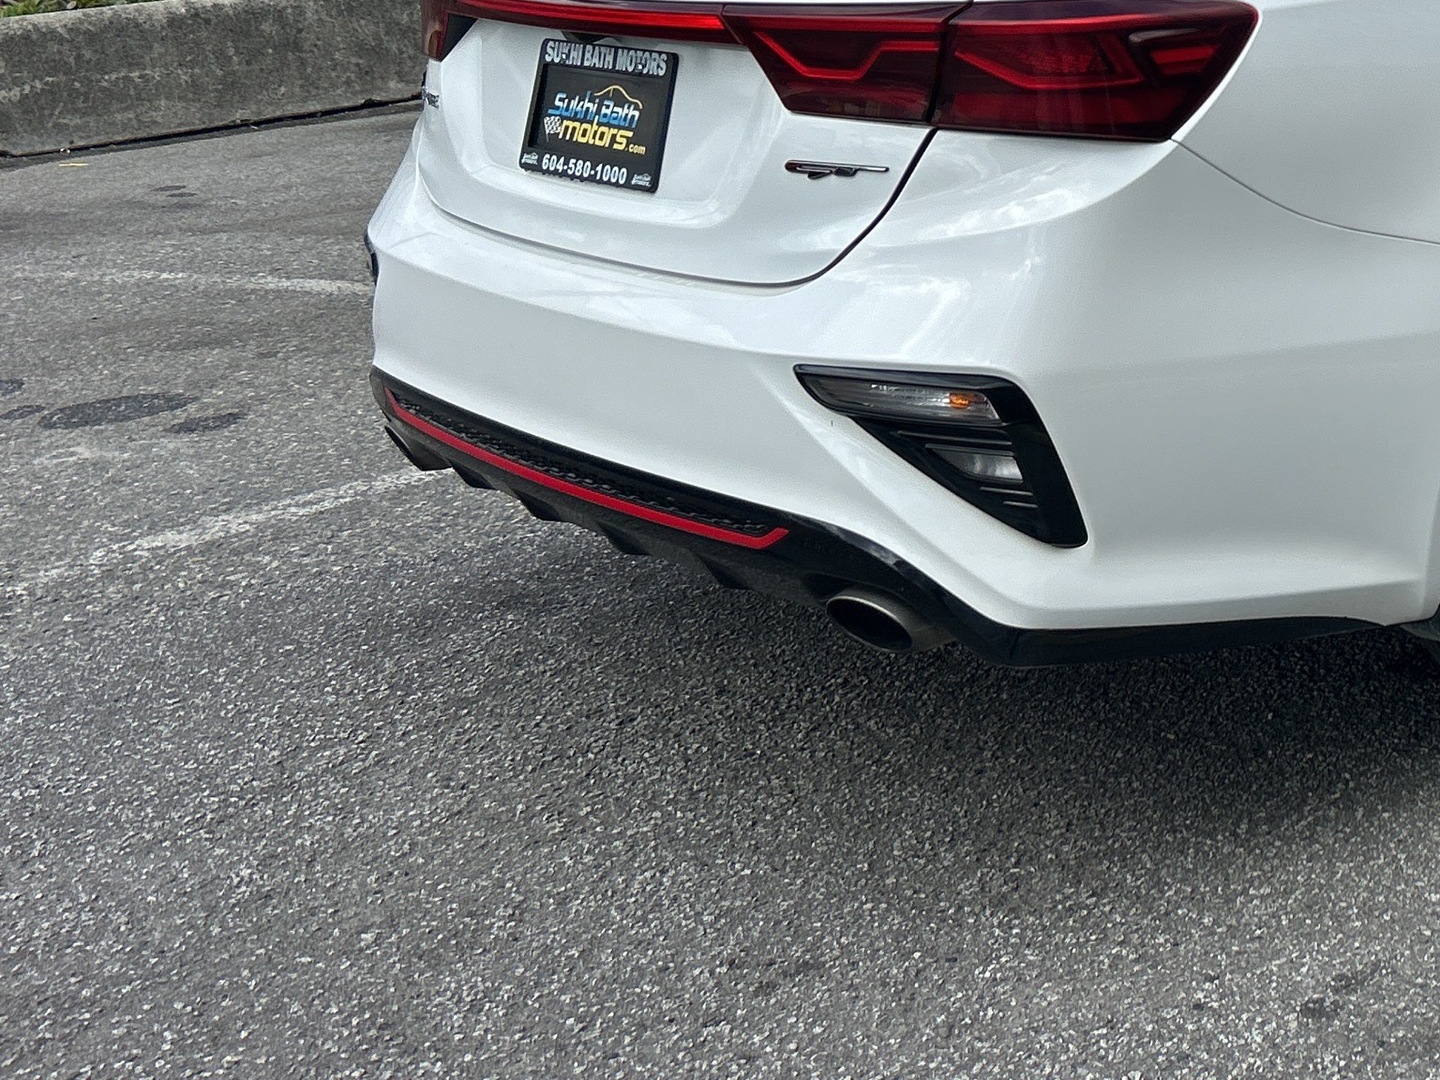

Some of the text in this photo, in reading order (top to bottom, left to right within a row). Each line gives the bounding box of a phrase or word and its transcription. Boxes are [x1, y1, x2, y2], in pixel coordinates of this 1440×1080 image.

[545, 41, 668, 77] SUKHI BATH MOTORS
[548, 91, 641, 129] Sukhi Bath
[541, 153, 628, 184] 604-580-1000
